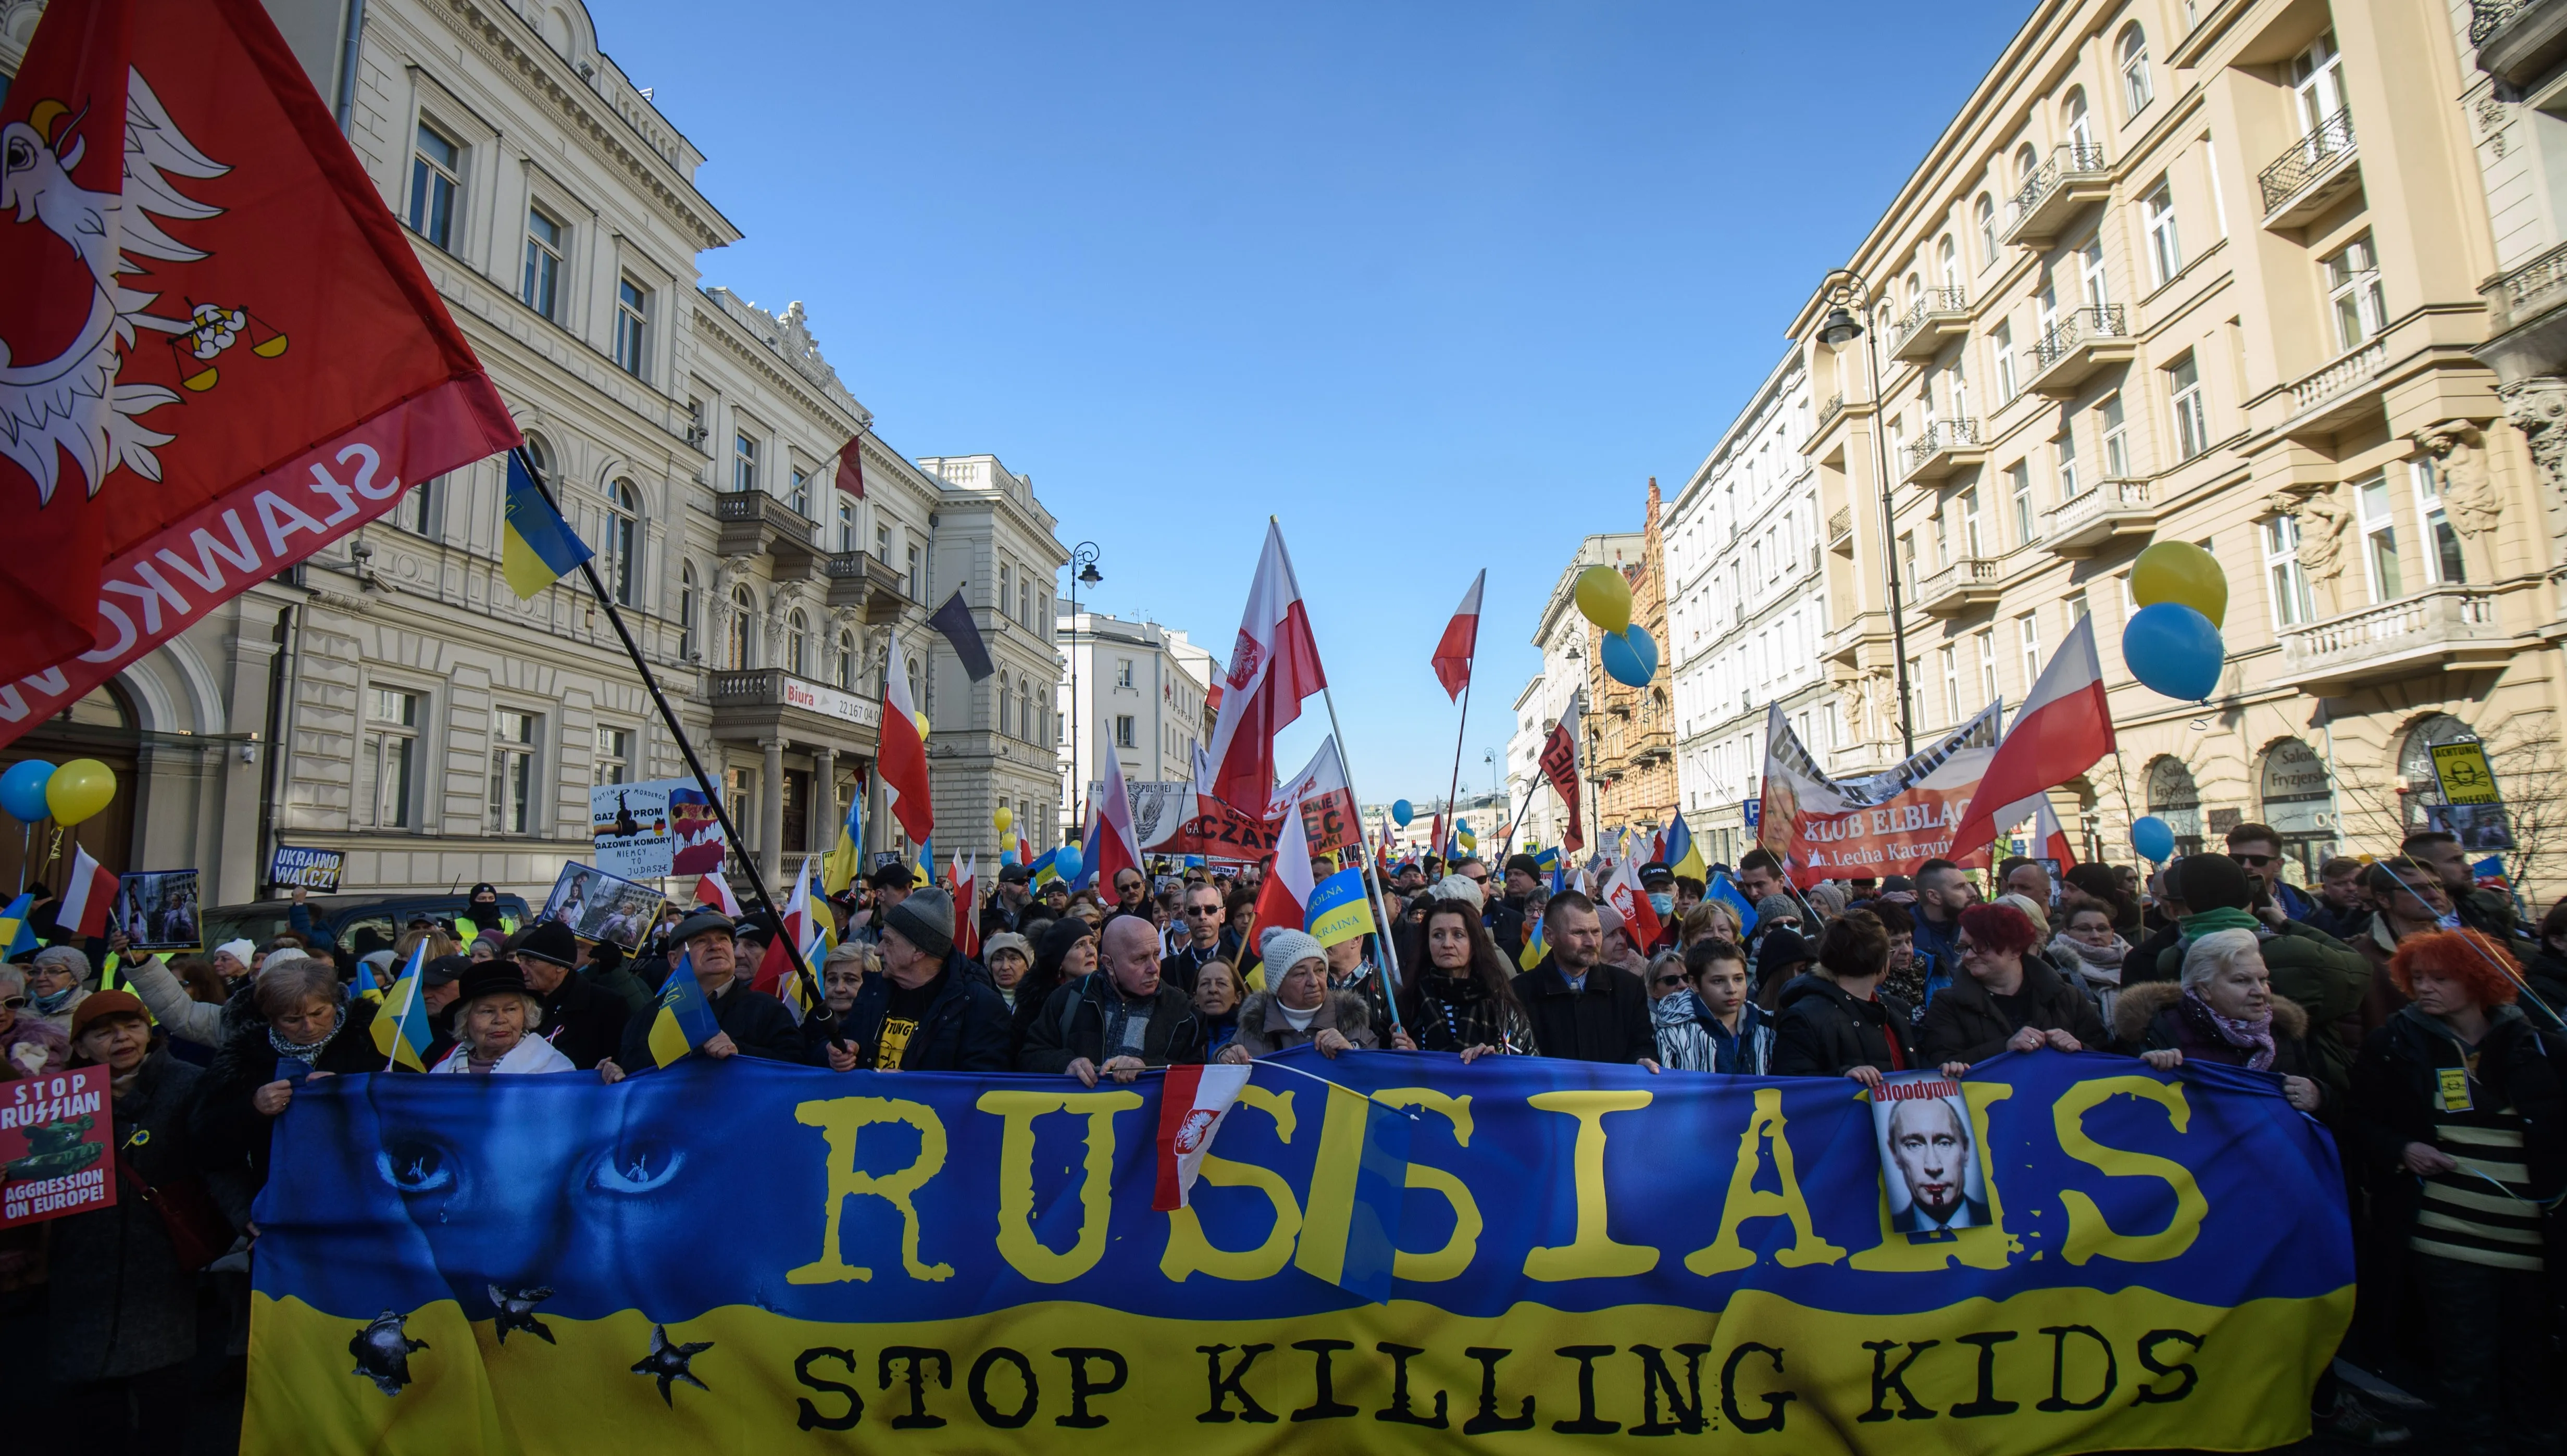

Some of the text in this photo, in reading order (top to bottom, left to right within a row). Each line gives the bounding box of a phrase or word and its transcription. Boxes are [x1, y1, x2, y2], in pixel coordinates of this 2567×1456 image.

[788, 685, 814, 707] Biura
[839, 700, 848, 714] 22
[849, 704, 863, 718] 167
[864, 708, 873, 721] 04
[1898, 714, 1995, 791] POLSKA
[2282, 748, 2315, 764] Salon
[2435, 745, 2480, 758] ACHTUNG
[593, 789, 666, 803] PUTIN MORDERCA
[1089, 783, 1171, 793] Kub POLSIEJ
[1263, 775, 1317, 815] KLUB
[594, 808, 663, 821] GAZ PROM
[1226, 808, 1275, 830] GAZEY
[1748, 801, 1761, 818] P
[1200, 810, 1344, 849] CZANEC
[1804, 813, 1865, 843] KLUB
[595, 836, 671, 849] GAZOWE KOMORY
[617, 848, 646, 858] NIEMCY
[1314, 833, 1343, 852] INKI
[1832, 845, 1884, 867] Lecha
[275, 865, 335, 888] WALCZ!
[627, 864, 668, 876] JUDASZE
[1310, 884, 1344, 913] WOLNA
[15, 1073, 86, 1105] STOP
[1873, 1077, 1959, 1102] Bloodymir
[1, 1090, 101, 1129] RUSSIAN
[5, 1169, 104, 1203] AGGRESSION
[5, 1184, 105, 1220] ON EUROPE!
[794, 1324, 2207, 1437] STOP KILLING KIDS
